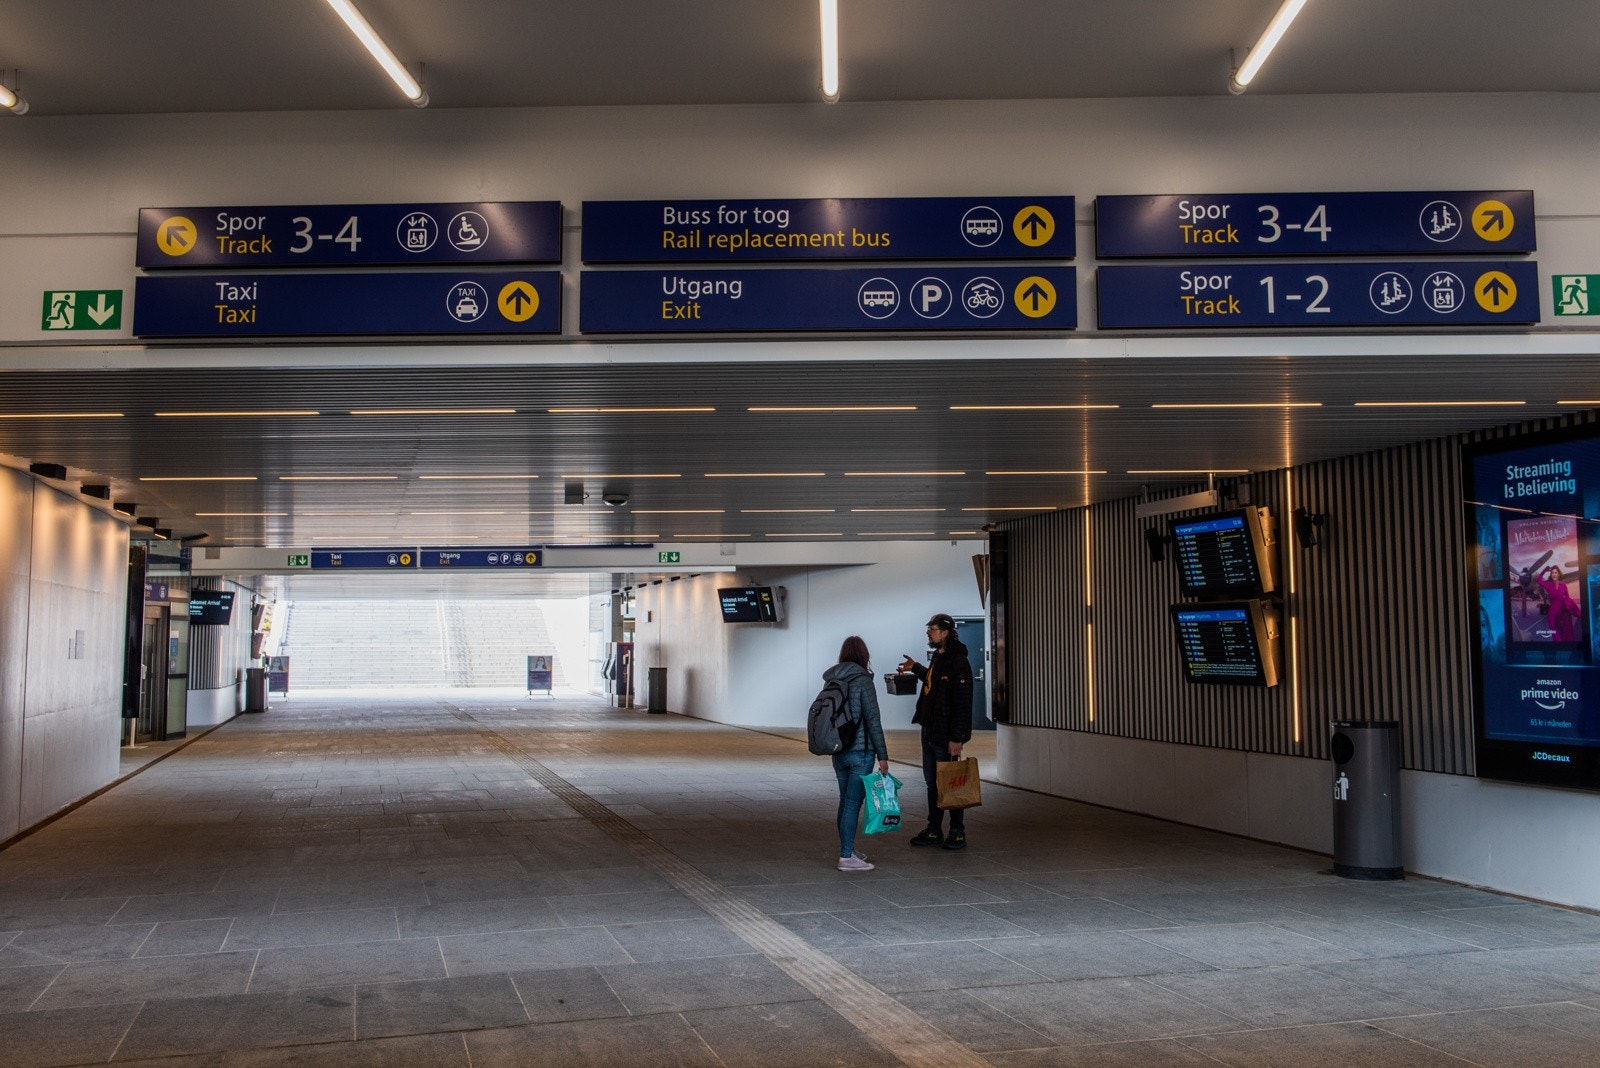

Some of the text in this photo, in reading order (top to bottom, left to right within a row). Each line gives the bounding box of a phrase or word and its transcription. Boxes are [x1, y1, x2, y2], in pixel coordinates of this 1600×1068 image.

[663, 205, 790, 229] Buss for tog
[1179, 200, 1332, 243] Spor 3-4
[216, 213, 362, 254] Spor 3-4
[663, 228, 890, 252] Rail replacement bus
[1179, 223, 1240, 244] Track
[216, 236, 272, 255] Track
[215, 281, 258, 301] Taxi
[457, 287, 477, 297] TAXI
[662, 276, 742, 299] Utgang
[1180, 271, 1331, 314] Spor 1-2
[215, 305, 257, 324] Taxi
[662, 300, 701, 320] Exit
[1181, 294, 1241, 315] Track
[1506, 460, 1571, 480] Streaming
[1504, 477, 1576, 498] Is Believing
[765, 604, 771, 615] 1
[1521, 687, 1579, 701] prime video
[1530, 718, 1538, 727] 65
[1538, 718, 1543, 727] kr
[1547, 718, 1572, 728] måneden
[1532, 751, 1570, 763] JCDecaux
